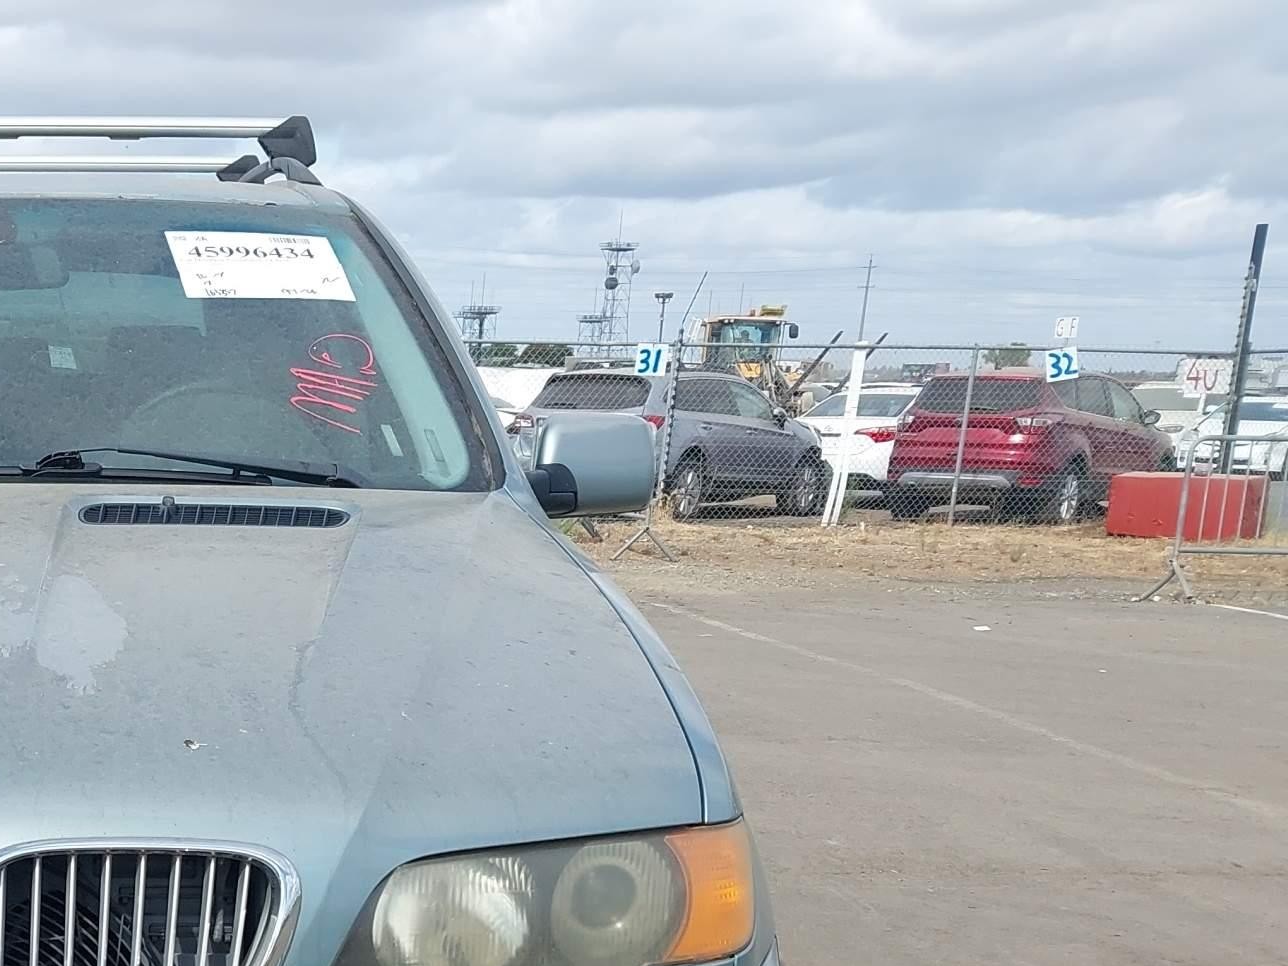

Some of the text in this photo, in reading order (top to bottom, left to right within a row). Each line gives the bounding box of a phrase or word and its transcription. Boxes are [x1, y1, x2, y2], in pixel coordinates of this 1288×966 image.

[188, 246, 315, 259] 45996434
[637, 348, 662, 373] 31
[1048, 352, 1079, 378] 32
